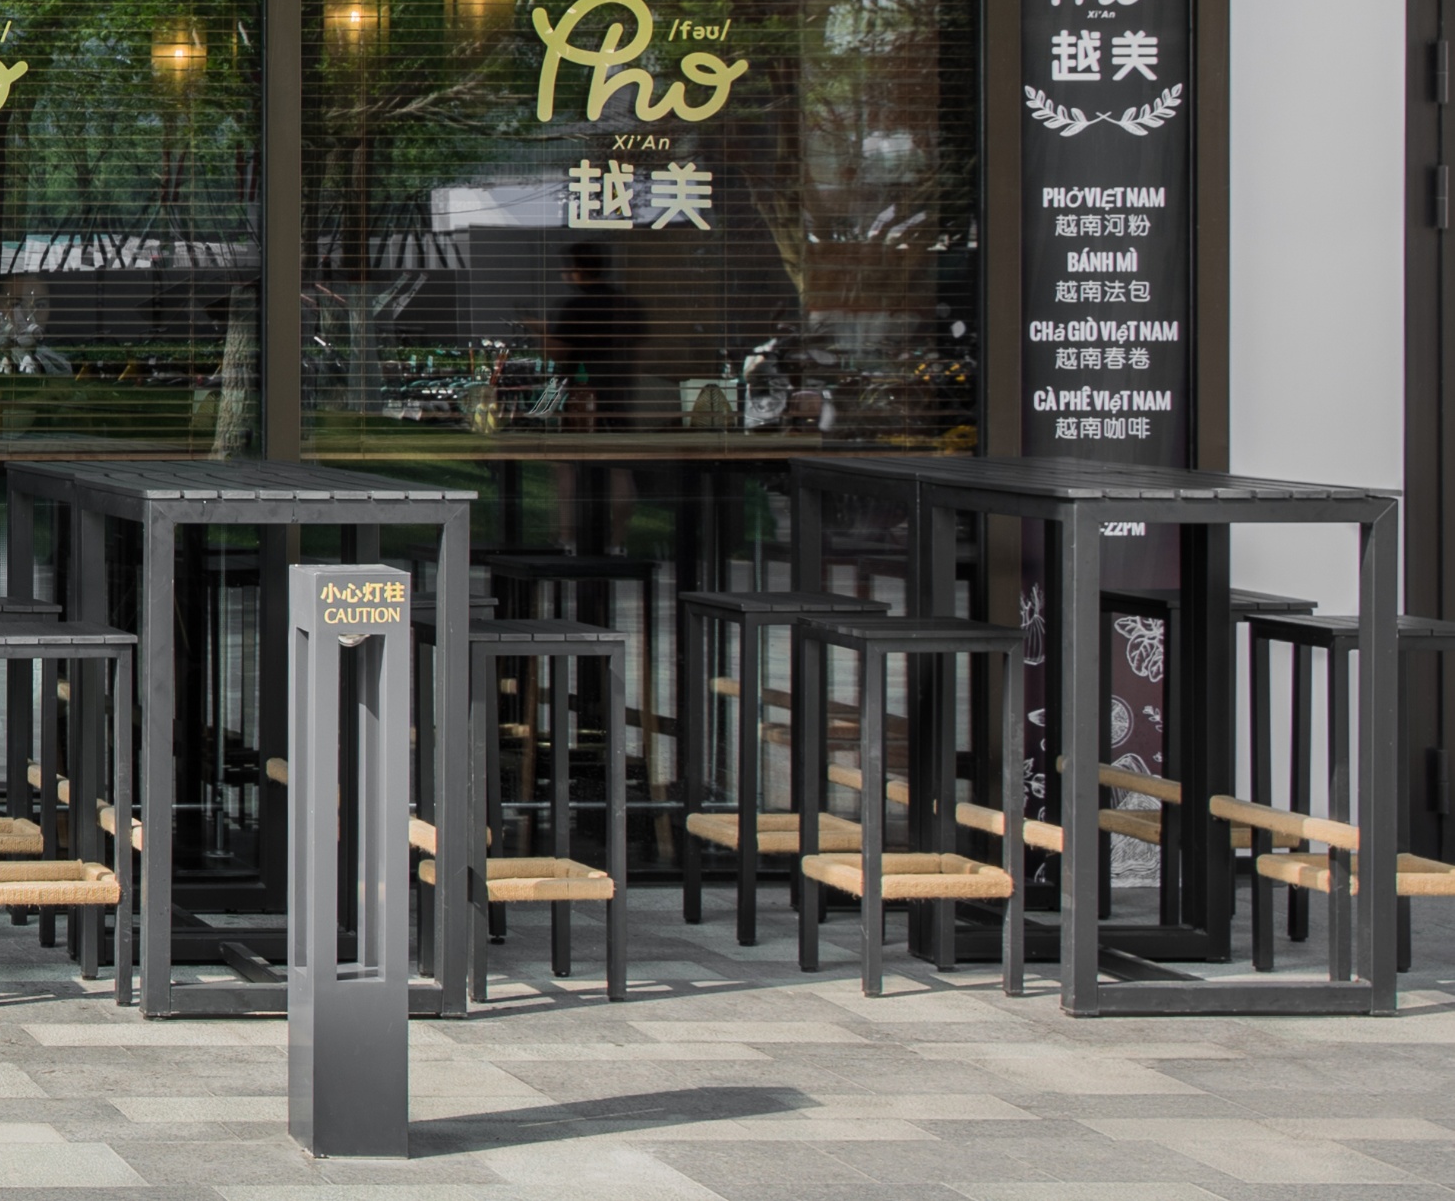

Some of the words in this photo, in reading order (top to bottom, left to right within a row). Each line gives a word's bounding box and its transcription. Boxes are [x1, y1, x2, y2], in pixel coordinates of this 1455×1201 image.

[1051, 30, 1158, 81] 越美
[568, 159, 712, 230] 越美
[1126, 187, 1165, 207] NAM
[1055, 214, 1151, 237] 越南河粉
[1067, 248, 1113, 272] BÁNH
[1116, 248, 1137, 272] MÌ
[1055, 280, 1151, 303] 越南法包
[1067, 317, 1097, 341] GIÒ
[1139, 320, 1178, 341] NAM
[1055, 347, 1151, 370] 越南春卷
[1033, 387, 1057, 411] CÀ
[1059, 386, 1091, 411] PHÊ
[1132, 390, 1172, 411] NAM
[1055, 417, 1151, 439] 越南咖啡
[320, 582, 405, 603] 小心灯柱
[324, 607, 401, 624] CAUTION
